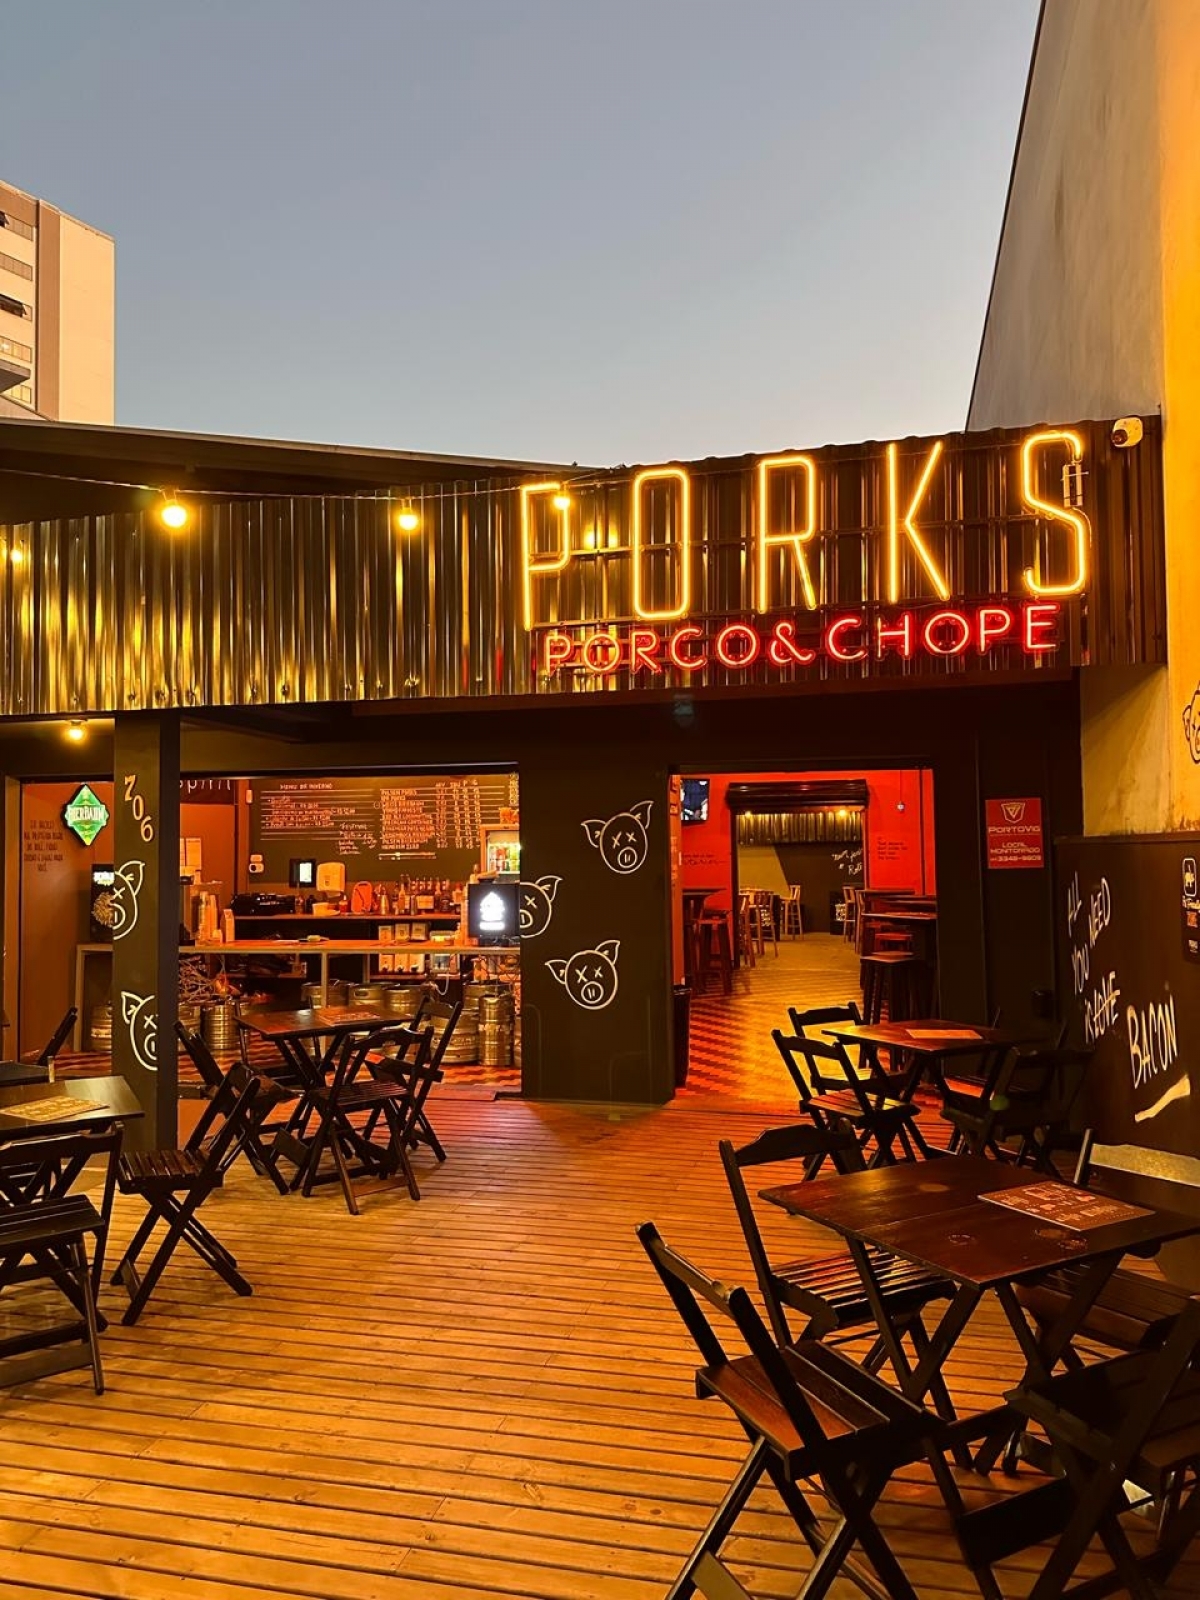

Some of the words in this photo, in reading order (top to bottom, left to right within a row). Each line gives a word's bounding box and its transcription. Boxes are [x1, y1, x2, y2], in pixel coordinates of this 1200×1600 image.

[521, 430, 1090, 631] PORKS
[124, 774, 154, 842] 706
[1088, 876, 1111, 949] NEED
[1126, 993, 1180, 1090] BACON
